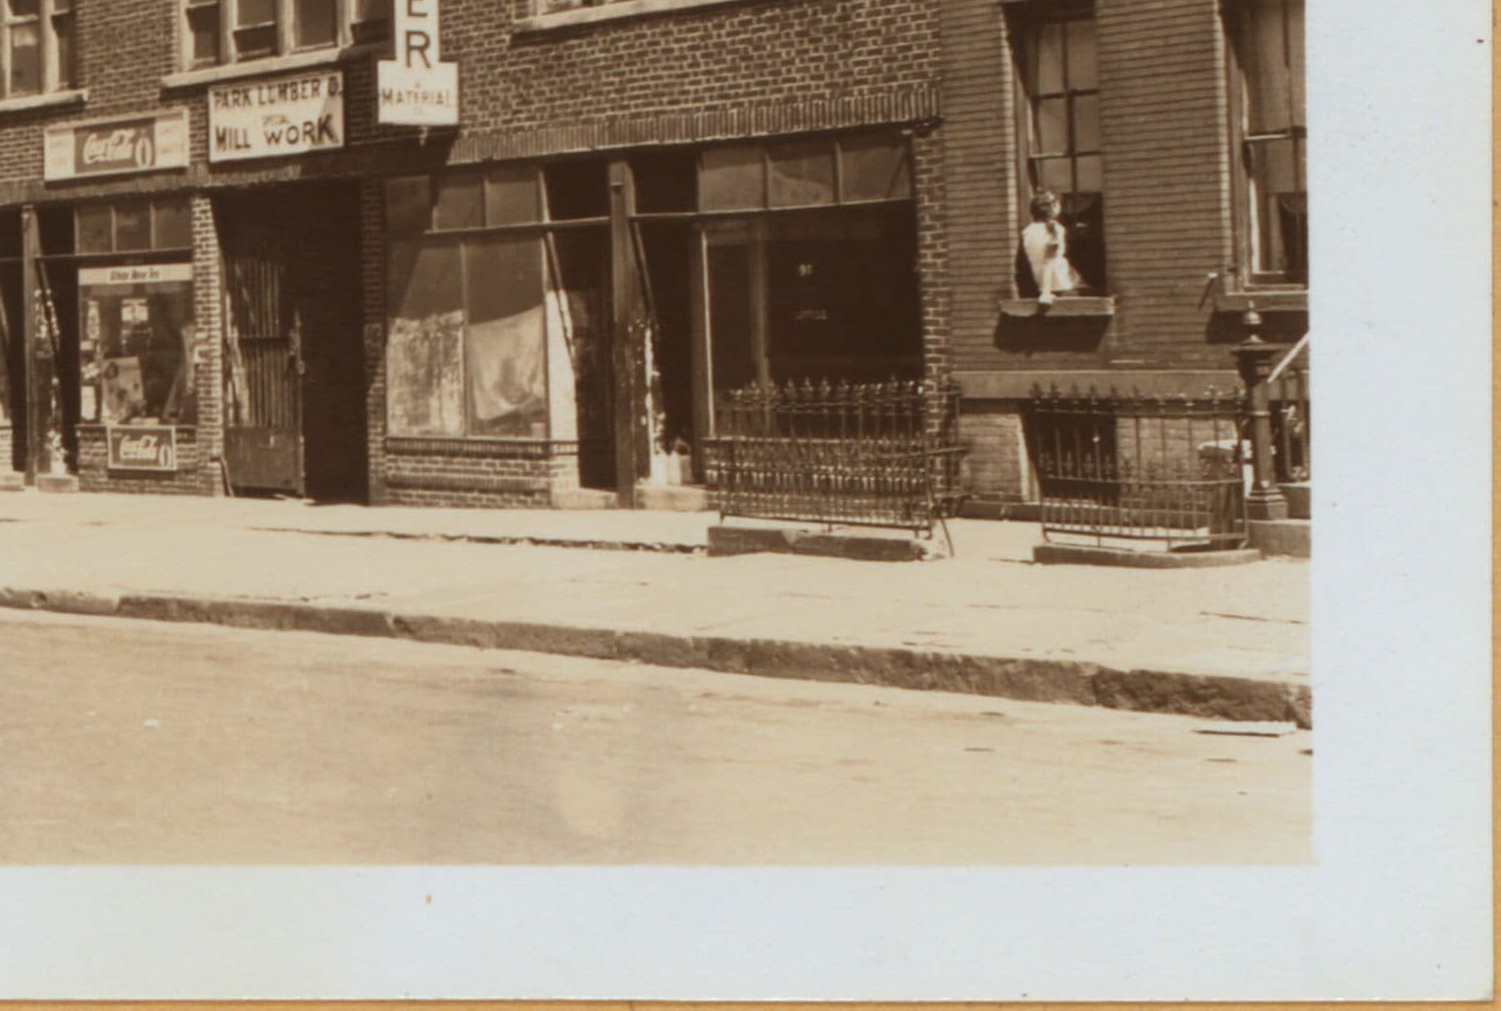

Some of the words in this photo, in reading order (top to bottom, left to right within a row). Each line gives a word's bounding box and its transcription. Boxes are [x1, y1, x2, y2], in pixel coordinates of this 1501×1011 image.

[214, 89, 253, 110] PARK
[257, 78, 321, 106] LUMBER
[381, 85, 453, 108] MATERIAL
[215, 125, 252, 152] MILL
[263, 113, 337, 146] WORK
